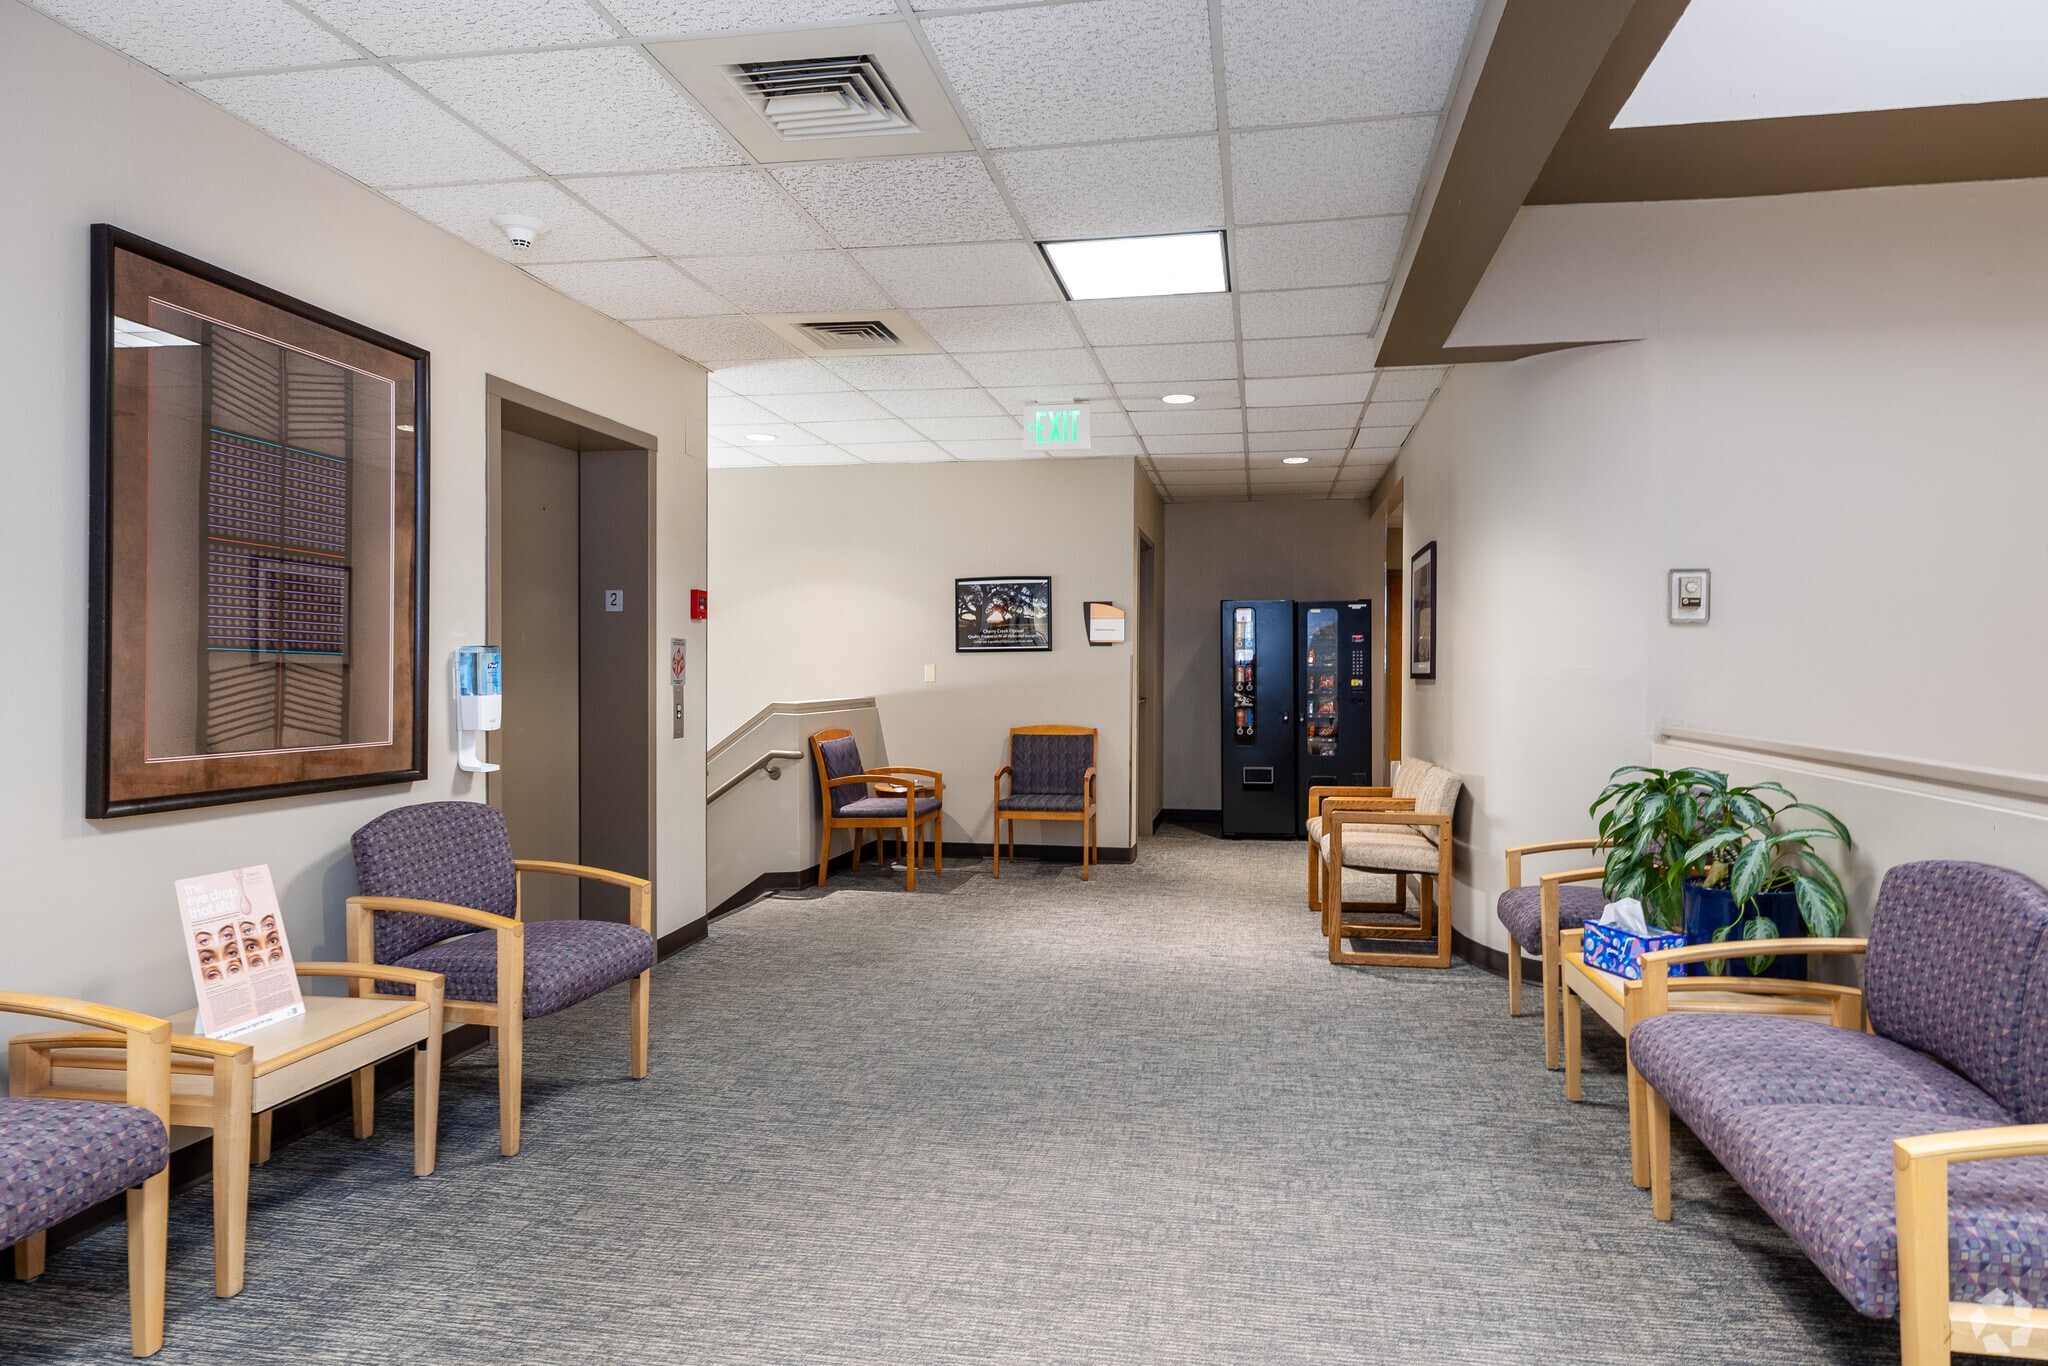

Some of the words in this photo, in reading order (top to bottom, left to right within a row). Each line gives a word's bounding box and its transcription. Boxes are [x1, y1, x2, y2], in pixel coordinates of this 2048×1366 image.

[1035, 410, 1081, 443] EXIT
[610, 592, 617, 606] 2
[184, 884, 205, 895] the
[186, 894, 208, 908] eye
[210, 888, 237, 901] drop
[189, 904, 215, 919] that
[215, 900, 236, 913] lifts
